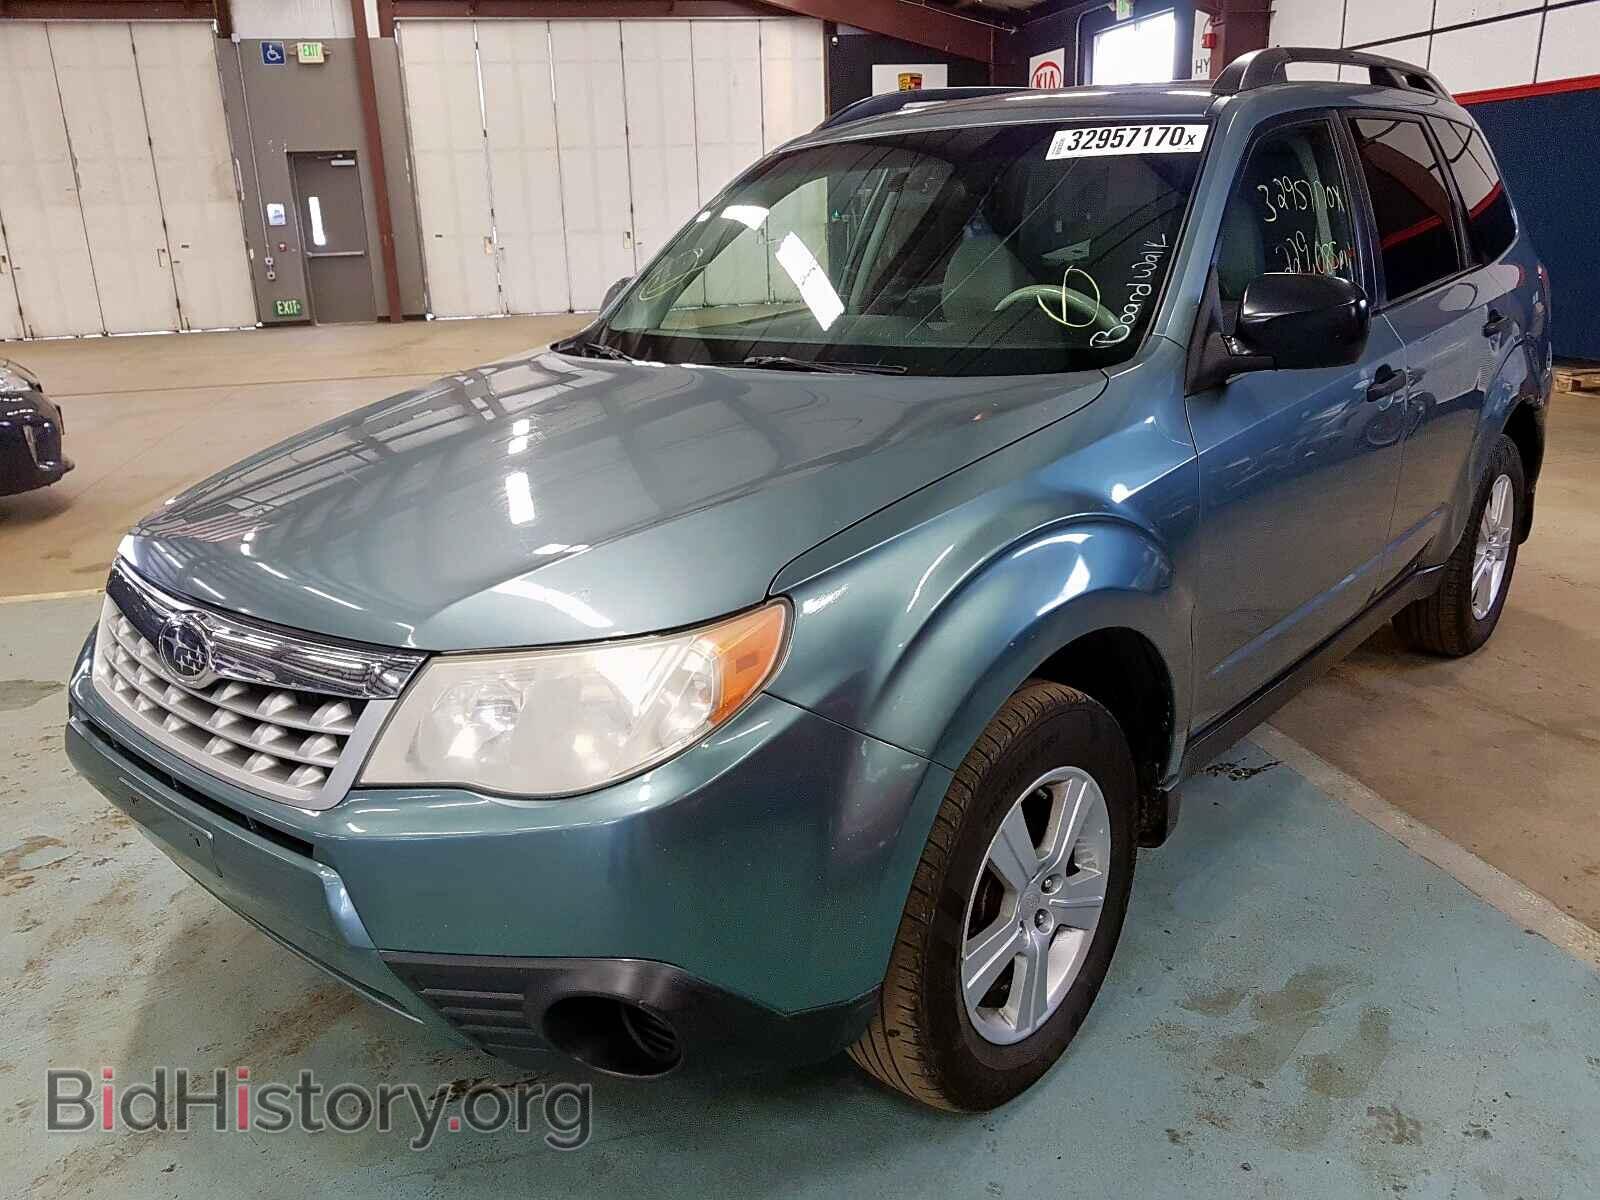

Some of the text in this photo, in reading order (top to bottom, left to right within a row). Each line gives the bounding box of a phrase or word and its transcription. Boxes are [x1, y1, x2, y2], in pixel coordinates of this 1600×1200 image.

[303, 44, 320, 56] EXIT
[1036, 71, 1056, 89] KIA
[277, 300, 297, 315] EXIT
